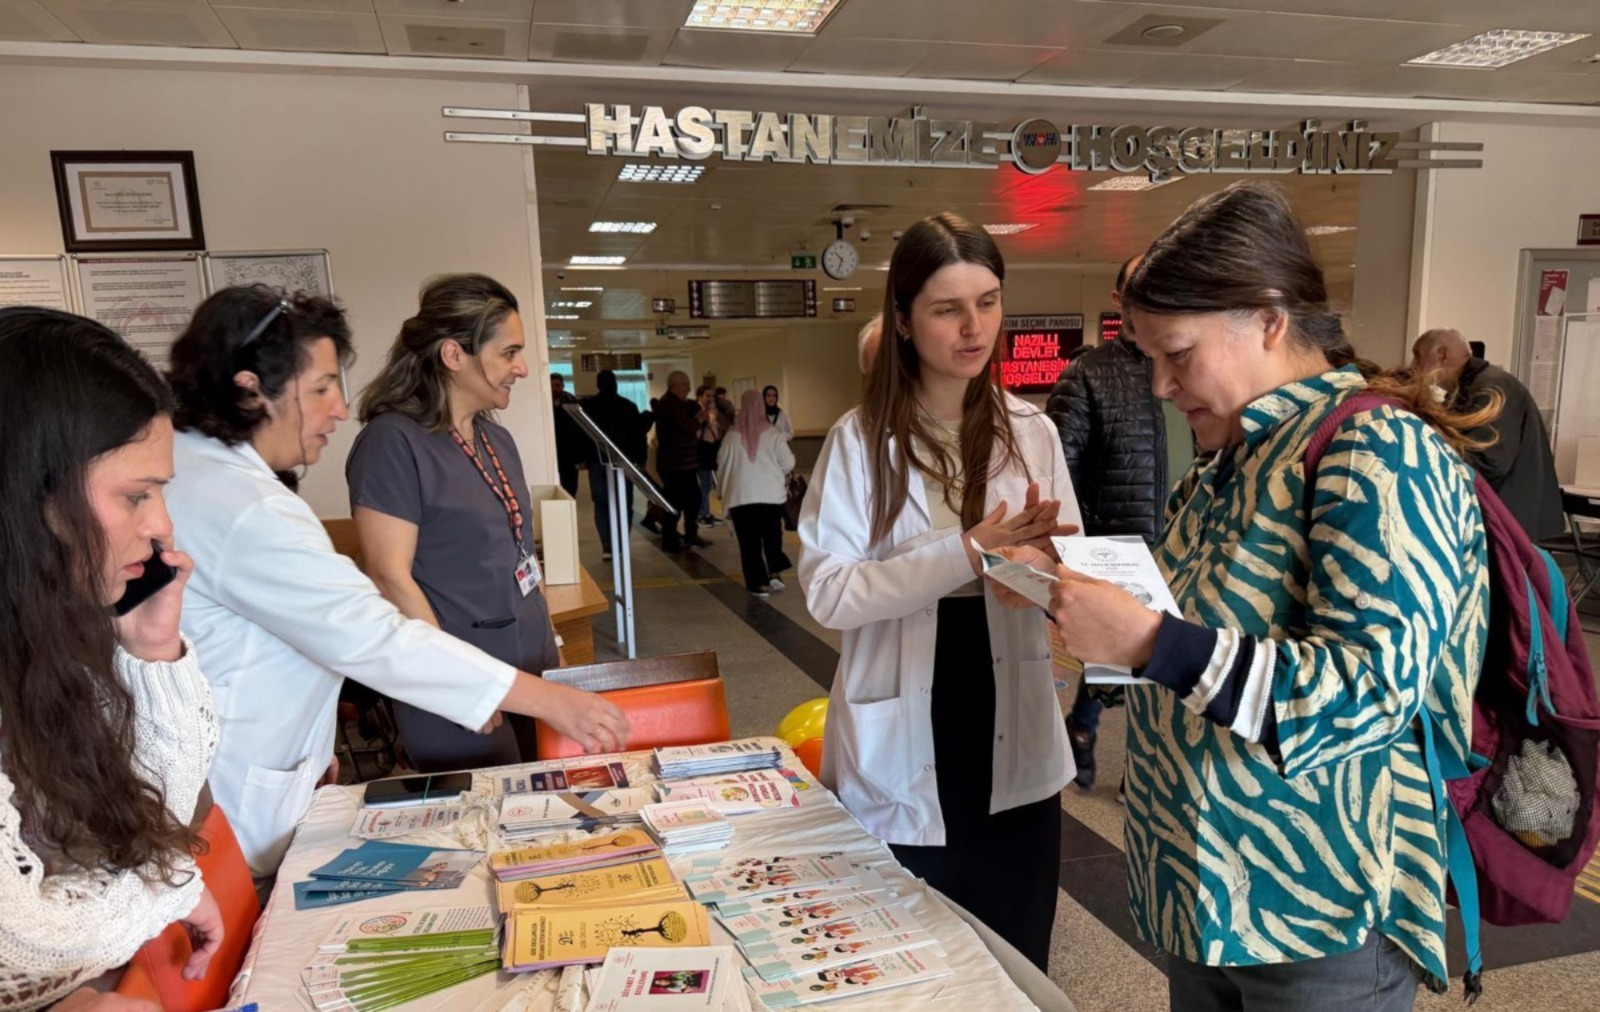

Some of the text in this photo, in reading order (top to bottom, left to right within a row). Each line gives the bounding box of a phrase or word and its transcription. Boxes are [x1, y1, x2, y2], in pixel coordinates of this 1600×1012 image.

[585, 102, 1400, 185] HASTANEMİZE HOŞGELDİNİZ
[1013, 346, 1061, 359] DEVLET
